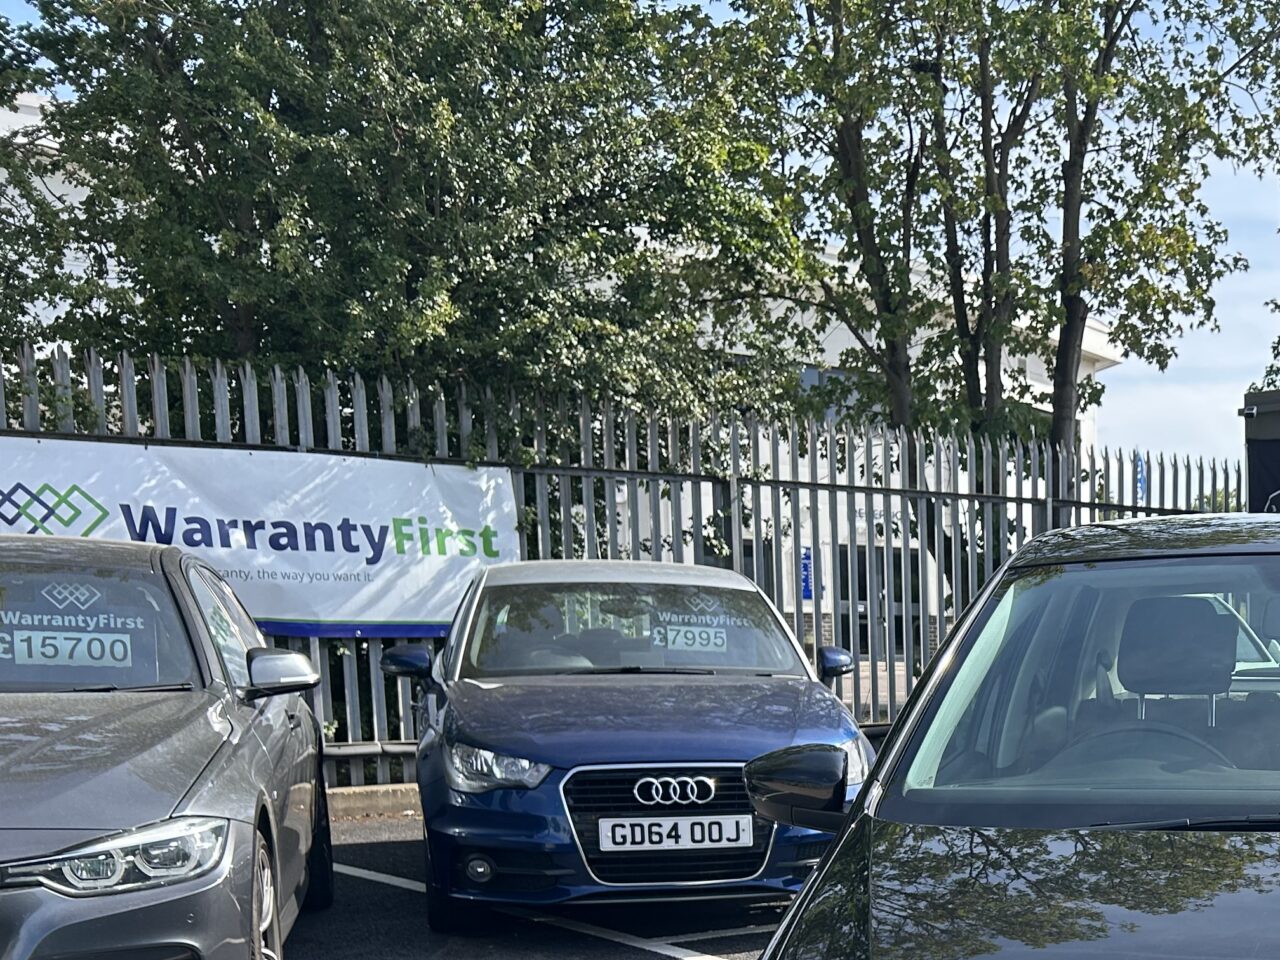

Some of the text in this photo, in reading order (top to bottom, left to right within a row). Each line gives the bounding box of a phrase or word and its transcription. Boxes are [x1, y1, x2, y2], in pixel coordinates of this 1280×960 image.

[119, 503, 500, 565] WarrantyFirst
[218, 568, 253, 581] anty,
[257, 568, 277, 580] the
[280, 571, 304, 583] way
[308, 571, 329, 584] you
[333, 571, 361, 582] want
[1, 611, 145, 631] WarrantyFirst
[657, 611, 749, 627] WarrantyFirst
[611, 820, 741, 846] GD64 OOJ
